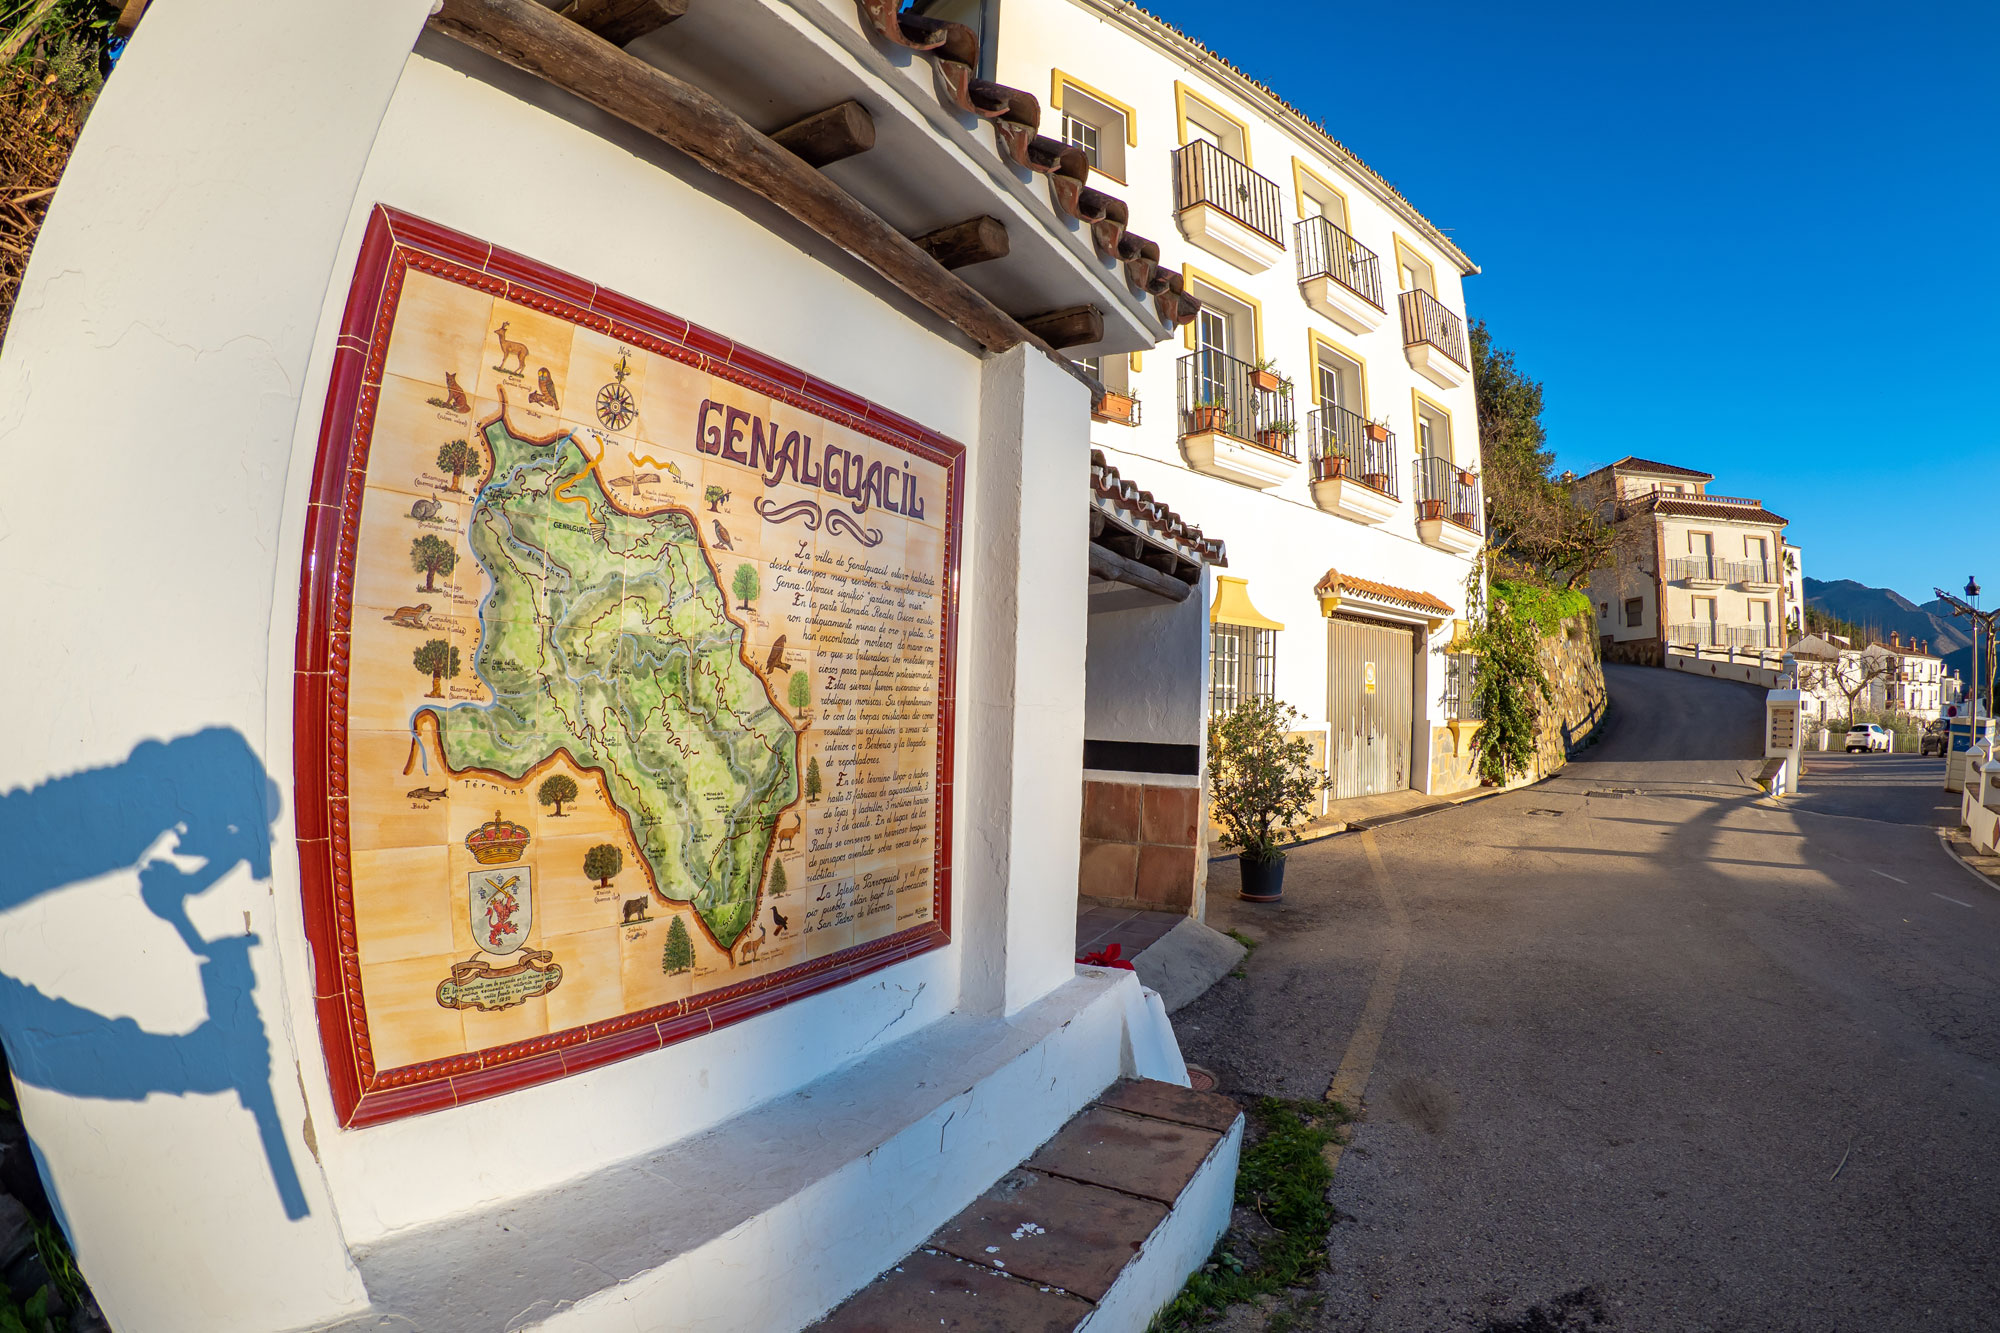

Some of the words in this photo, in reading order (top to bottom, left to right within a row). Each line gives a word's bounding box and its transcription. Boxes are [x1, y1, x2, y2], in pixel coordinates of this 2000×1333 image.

[769, 557, 791, 572] desde
[797, 561, 827, 581] tiempos
[831, 573, 848, 588] muy
[881, 580, 891, 591] Su
[795, 540, 811, 559] La
[815, 549, 833, 564] villa
[836, 554, 845, 567] de
[845, 556, 888, 578] Genalguacil
[911, 570, 935, 586] habitada
[792, 592, 806, 607] En
[809, 597, 817, 609] la
[816, 600, 838, 616] parte
[841, 603, 869, 616] llamada
[872, 605, 894, 620] Reales
[897, 611, 914, 622] Chicos
[897, 597, 906, 608] del
[787, 614, 801, 622] ron
[805, 614, 852, 632] antiguamente
[856, 622, 876, 632] minas
[879, 622, 886, 632] de
[902, 630, 908, 641] y
[927, 629, 935, 640] Se
[802, 625, 817, 641] han
[820, 632, 860, 645] encontrado
[864, 634, 893, 650] morteros
[897, 638, 906, 650] de
[925, 645, 934, 653] con
[817, 645, 827, 657] los
[830, 651, 843, 664] que
[892, 653, 900, 663] los
[818, 664, 838, 675] ciosos
[839, 667, 857, 679] para
[858, 664, 894, 683] purificarlos
[825, 675, 847, 691] Estas
[849, 682, 871, 691] sierras
[873, 680, 893, 697] fueron
[923, 682, 930, 692] de
[820, 693, 852, 706] rebeliones
[885, 694, 895, 707] Su
[823, 709, 831, 720] to
[833, 713, 845, 721] con
[847, 708, 856, 720] las
[859, 708, 880, 725] tropas
[882, 708, 910, 721] cristianas
[911, 708, 921, 720] dio
[824, 725, 854, 736] resultado
[866, 723, 896, 740] expulsión
[922, 722, 930, 733] de
[824, 740, 849, 751] interior
[892, 743, 898, 754] y
[899, 736, 905, 748] la
[906, 736, 926, 753] llegada
[825, 755, 833, 768] de
[836, 771, 849, 787] En
[851, 770, 864, 786] este
[913, 768, 929, 779] haber
[827, 791, 844, 803] hasta
[879, 785, 886, 797] de
[925, 781, 929, 790] 3
[823, 808, 832, 819] de
[834, 806, 848, 822] tejas
[852, 808, 857, 820] y
[885, 800, 890, 810] 3
[890, 797, 912, 808] molinos
[814, 827, 824, 836] ros
[827, 826, 833, 839] y
[834, 823, 840, 833] 3
[841, 818, 849, 832] de
[875, 814, 885, 826] En
[886, 811, 893, 823] el
[894, 812, 908, 827] lugar
[911, 807, 918, 819] de
[919, 806, 927, 818] los
[808, 837, 833, 853] Reales
[835, 840, 842, 848] se
[844, 835, 871, 847] conserva
[884, 825, 908, 838] hermoso
[909, 821, 927, 839] bosque
[808, 855, 817, 868] de
[816, 854, 846, 871] pinsapos
[847, 843, 875, 859] asentado
[877, 840, 893, 854] sobre
[912, 837, 919, 845] de
[816, 884, 831, 901] La
[835, 882, 860, 901] Iglesia
[862, 868, 901, 890] Parroquial
[803, 907, 819, 924] pio
[820, 898, 846, 921] pueblo
[850, 894, 867, 907] están
[869, 890, 885, 906] bajo
[887, 884, 894, 897] la
[803, 921, 814, 934] de
[817, 919, 832, 931] San
[834, 910, 854, 926] Pedro
[857, 906, 864, 918] de
